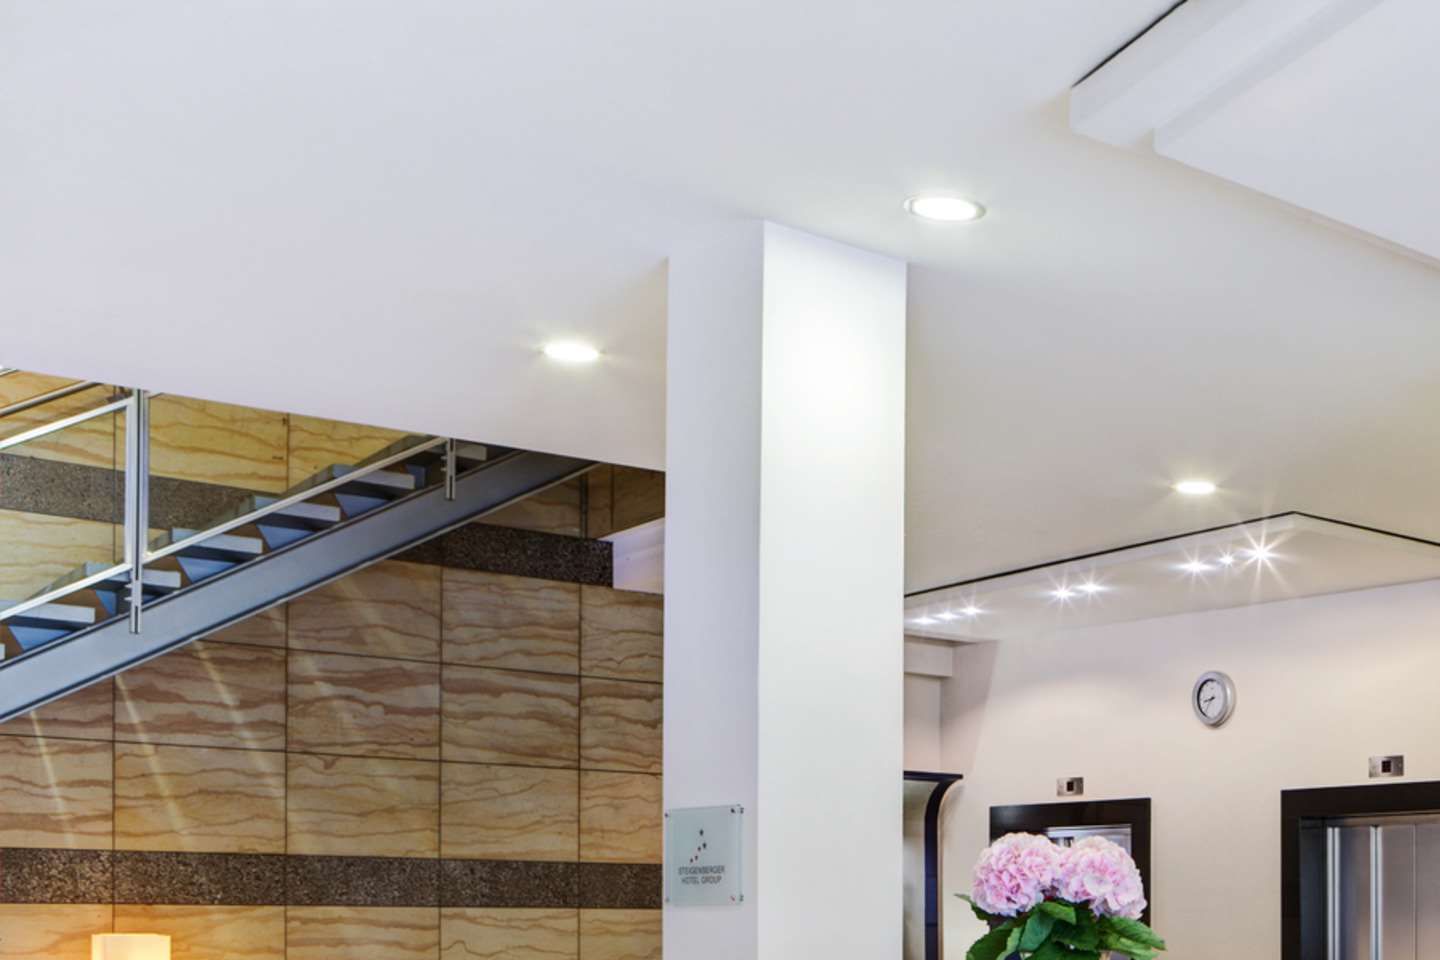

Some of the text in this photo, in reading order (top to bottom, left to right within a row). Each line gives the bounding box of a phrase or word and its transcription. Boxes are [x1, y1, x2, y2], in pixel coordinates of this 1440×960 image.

[678, 865, 725, 875] STEIGENBERGER
[681, 875, 722, 885] HOTEL GROUP
